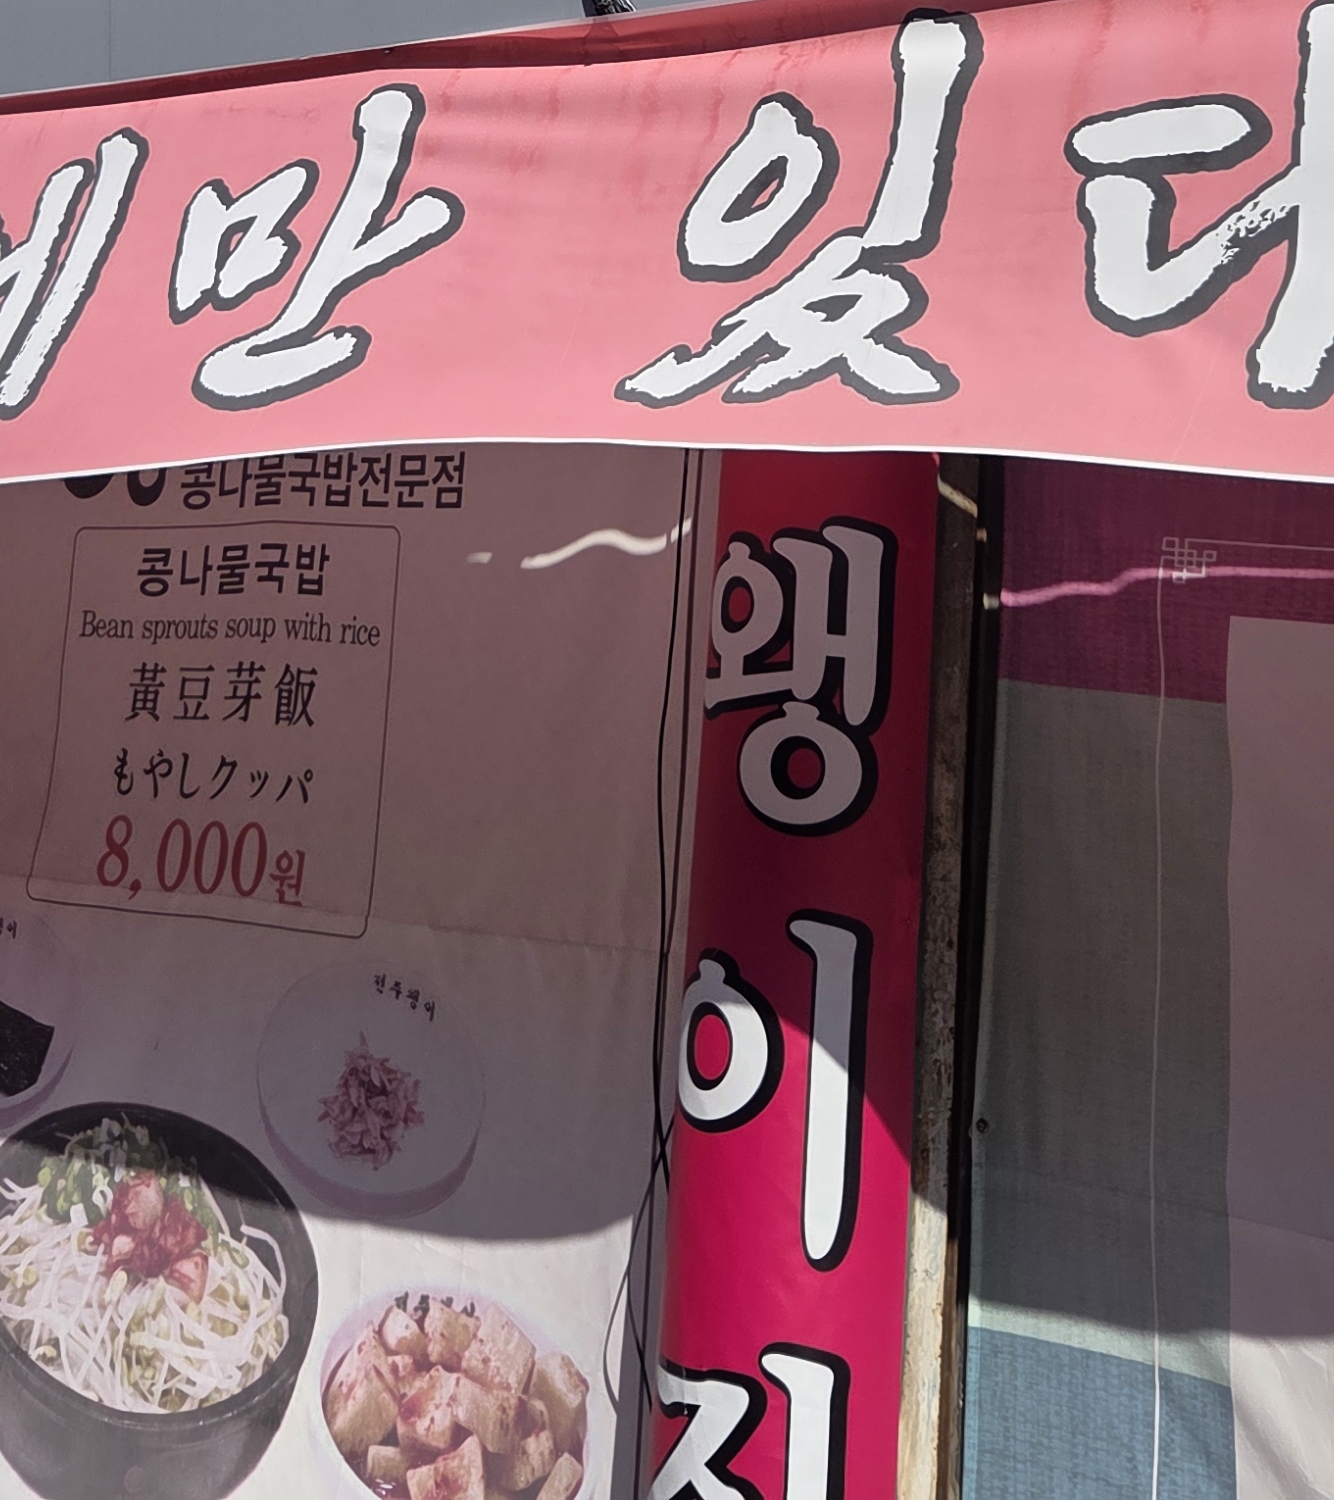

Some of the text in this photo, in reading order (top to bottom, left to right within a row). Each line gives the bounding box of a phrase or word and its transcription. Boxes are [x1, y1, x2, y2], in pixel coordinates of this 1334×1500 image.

[180, 451, 466, 511] 콩나물국밥전문점
[137, 543, 330, 597] 콩나물국밥
[78, 609, 381, 647] Bean sprouts soup with rice
[113, 747, 314, 804] もやしクッパ
[96, 814, 306, 907] 8,000원
